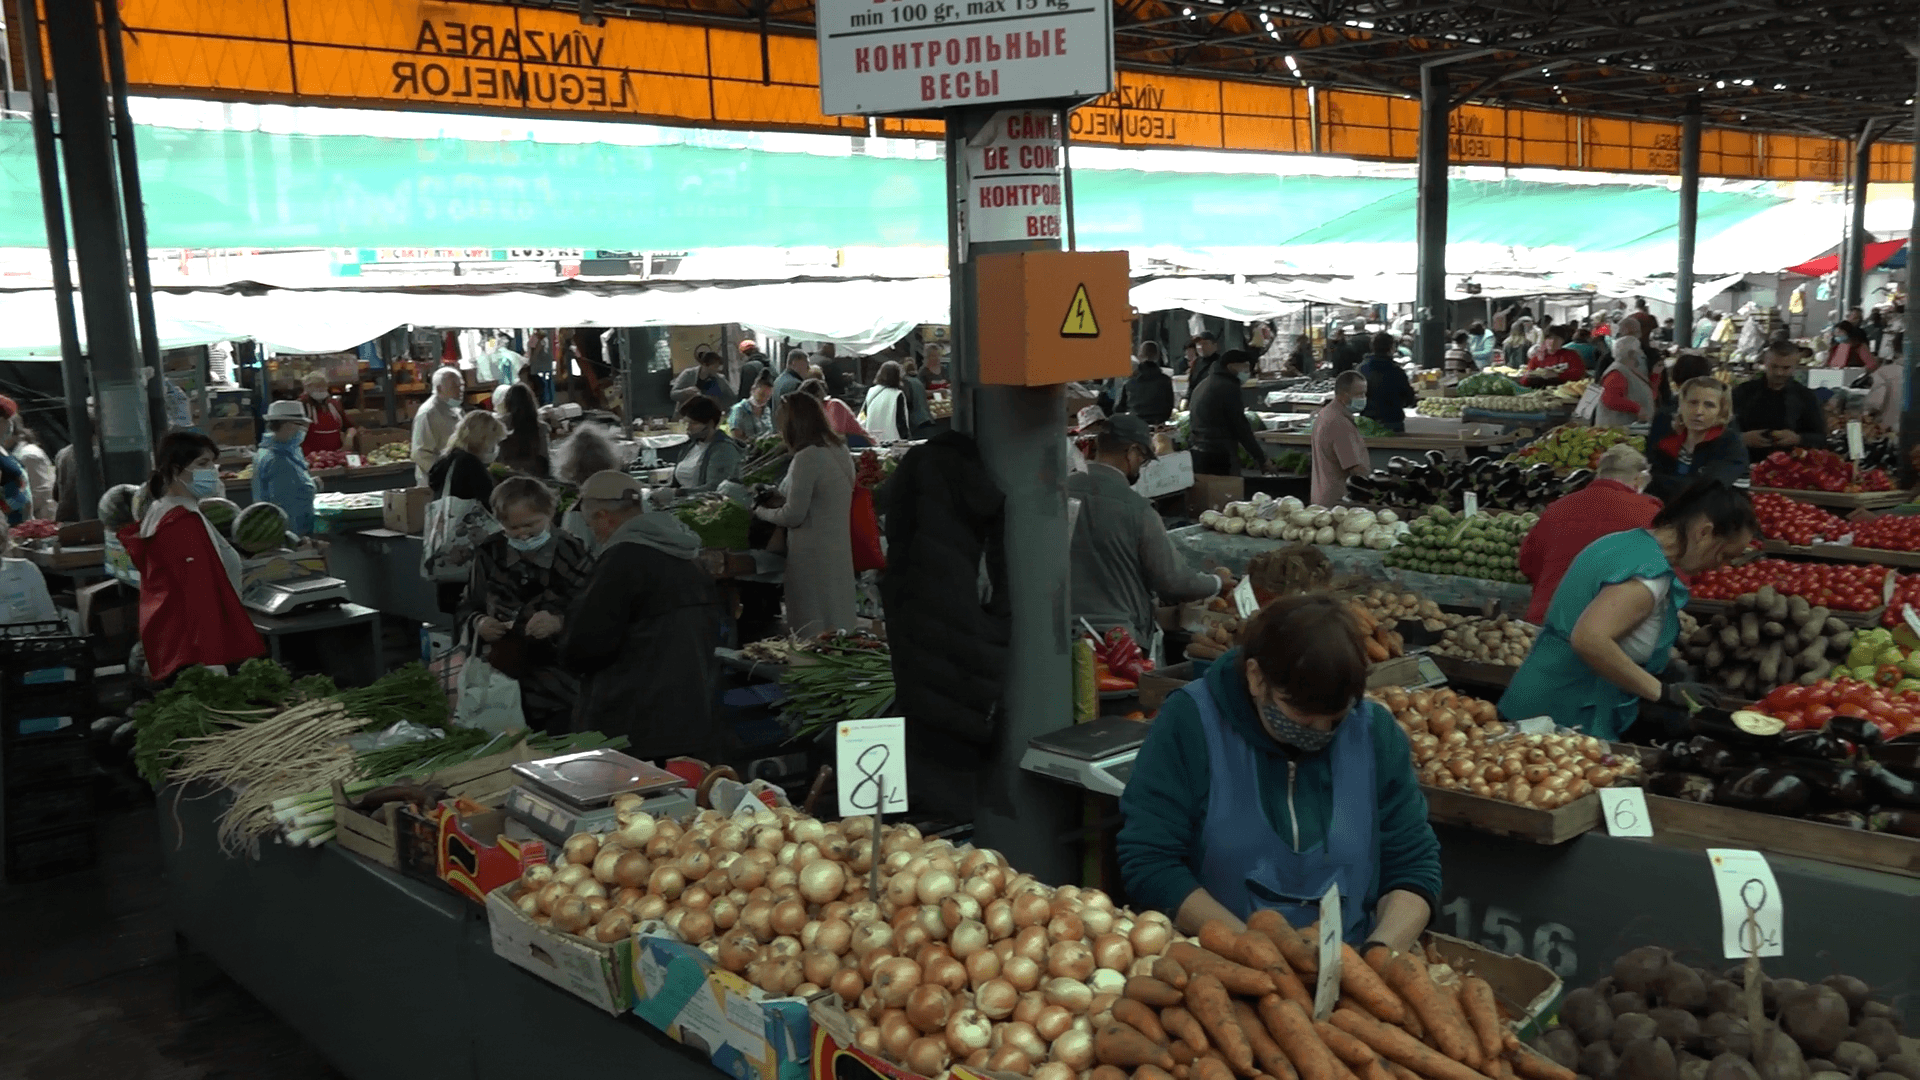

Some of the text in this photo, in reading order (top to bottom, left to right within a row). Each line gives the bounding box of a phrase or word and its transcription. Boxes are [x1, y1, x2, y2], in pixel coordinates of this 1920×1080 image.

[851, 9, 883, 27] min
[891, 4, 927, 23] 100
[967, 0, 1006, 15] max
[855, 27, 1067, 74] КОНТРОЛЬНЫЕ
[920, 69, 999, 102] ВЕСЫ
[984, 146, 1009, 170] DE
[1614, 798, 1638, 830] 6
[1442, 896, 1578, 977] 156
